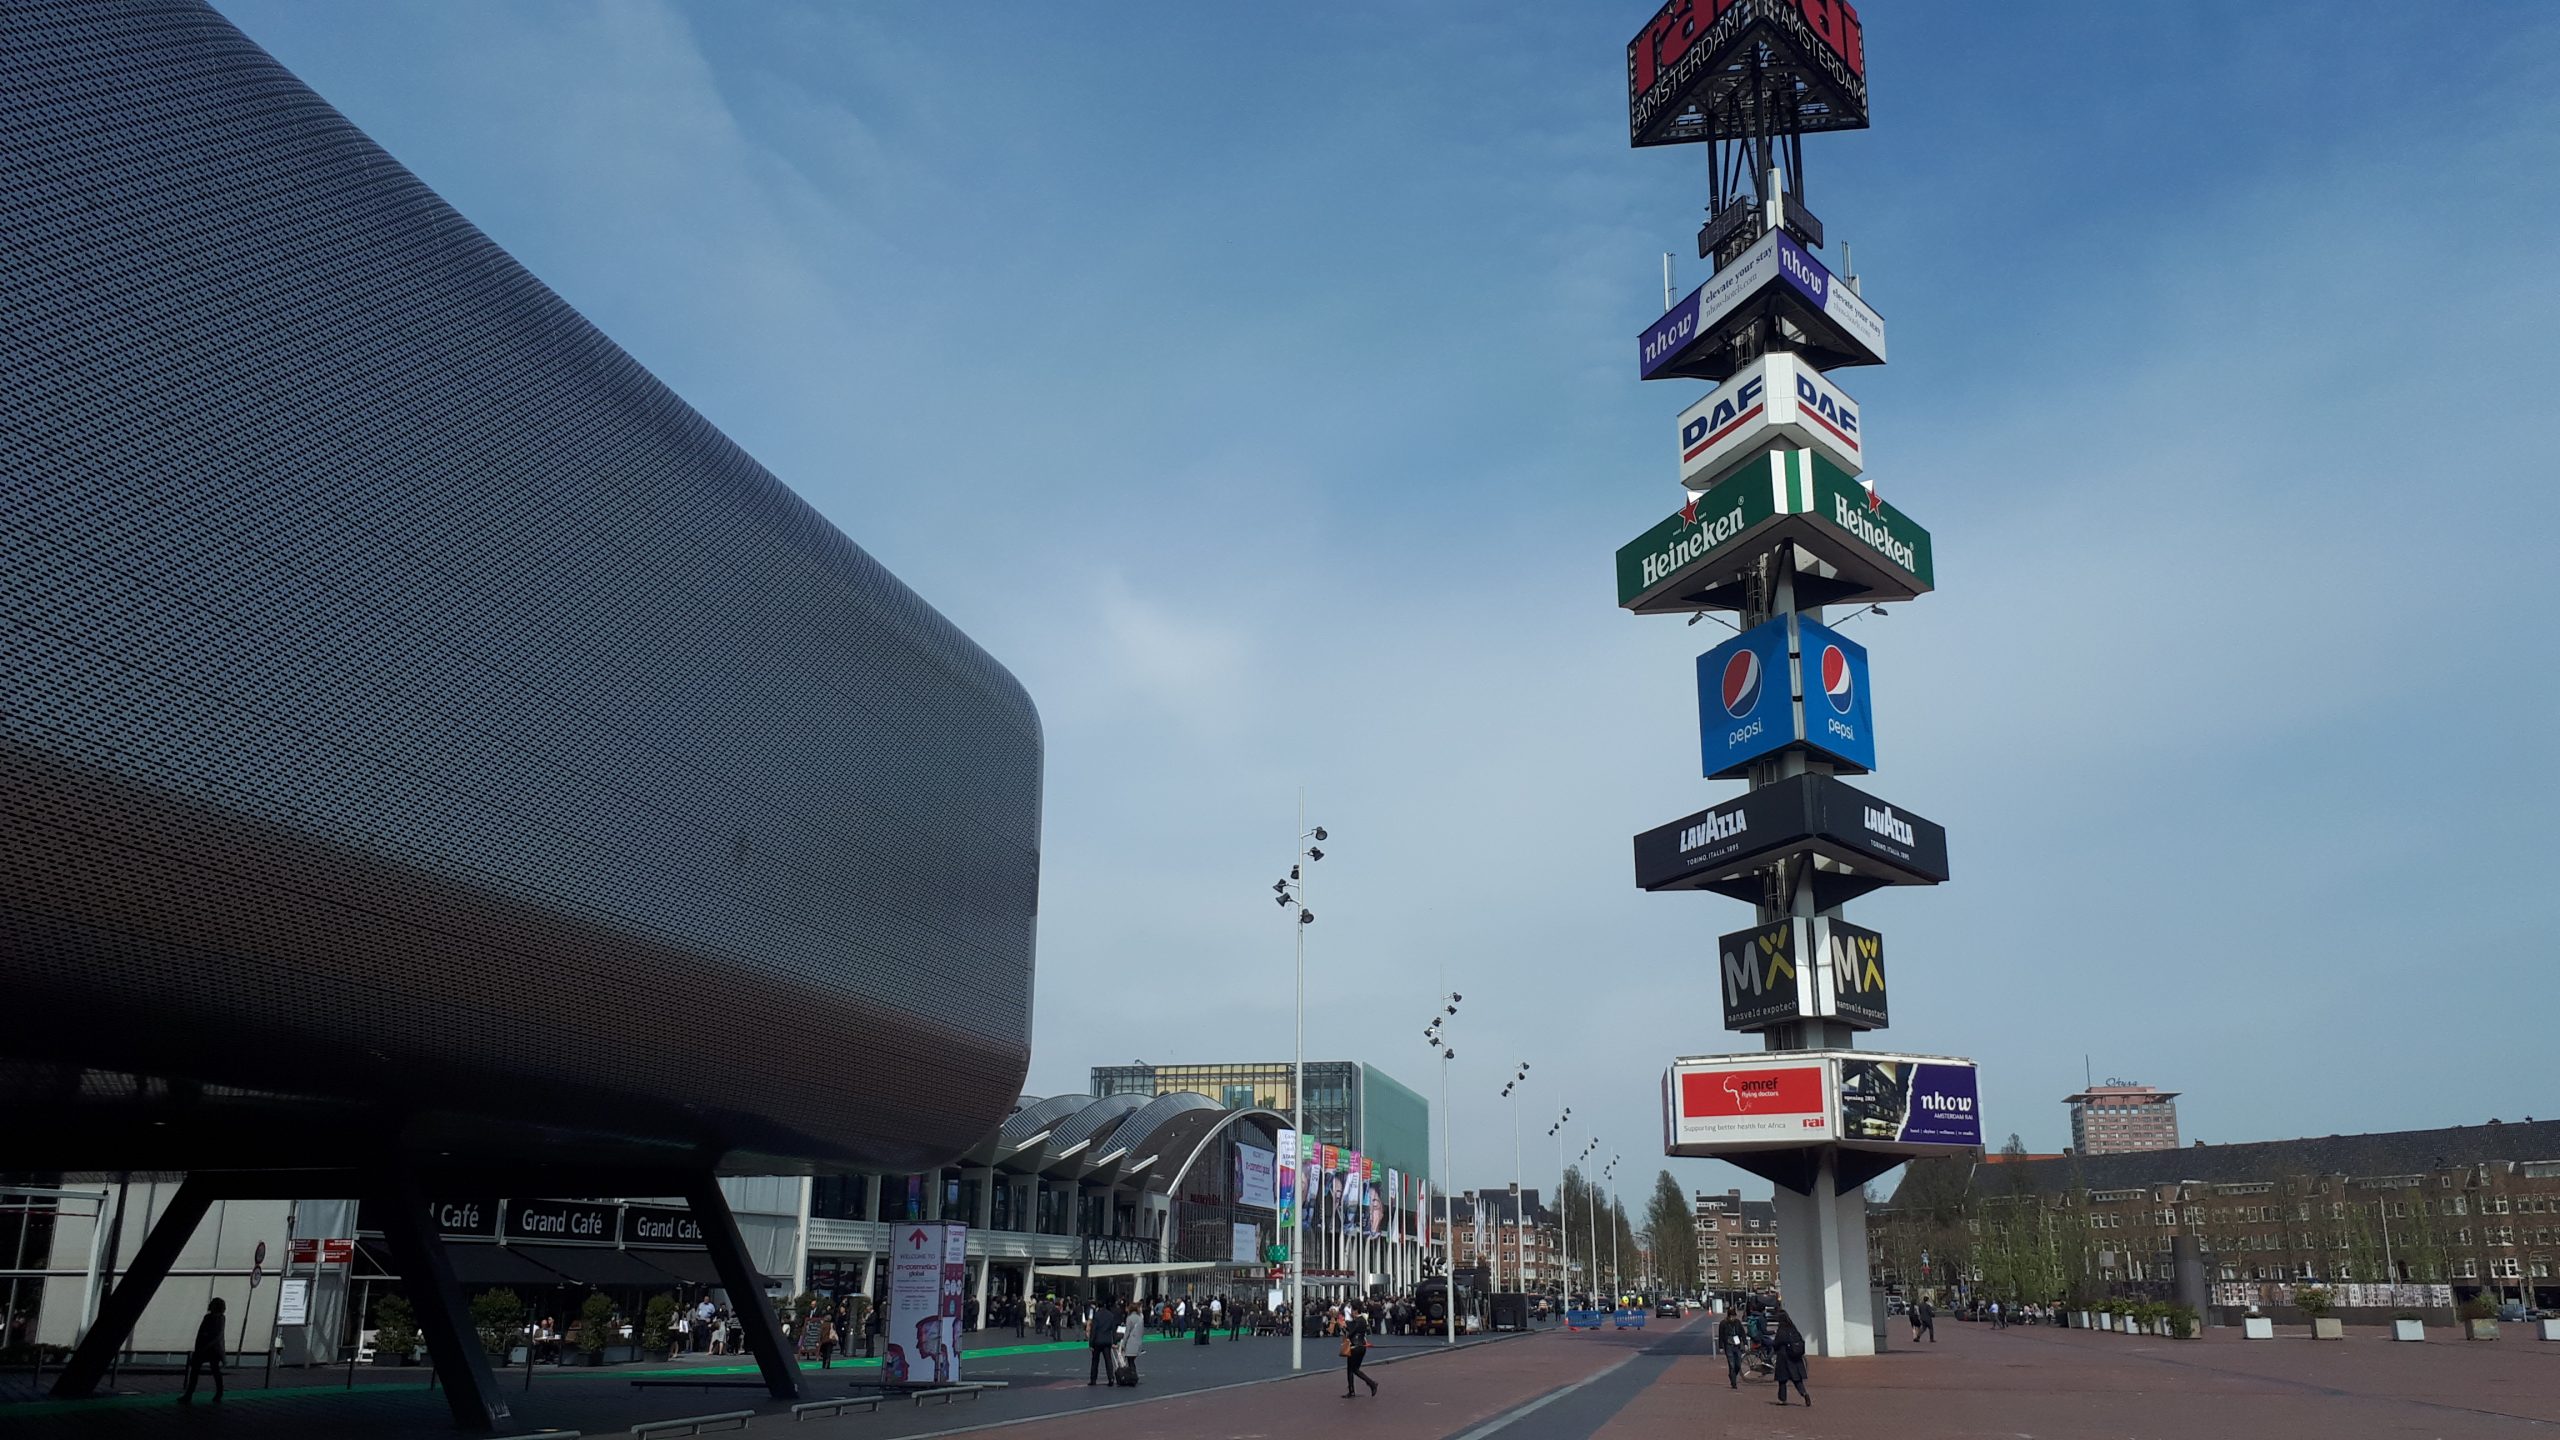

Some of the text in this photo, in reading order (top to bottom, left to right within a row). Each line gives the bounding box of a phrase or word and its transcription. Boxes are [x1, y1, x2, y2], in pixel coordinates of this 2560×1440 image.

[1636, 0, 1735, 95] ra
[1781, 6, 1866, 107] AMSTERDAM
[1784, 0, 1862, 79] ai
[1637, 8, 1739, 126] AMSTERDAM
[1705, 245, 1774, 304] elevate your stay
[1781, 247, 1822, 295] nhow
[1645, 313, 1692, 364] nhow
[1682, 374, 1762, 450] DAF
[1796, 373, 1857, 433] DAF
[1641, 505, 1745, 588] Heineken
[1834, 492, 1915, 573] Heineken
[1729, 717, 1762, 749] pepsi
[1828, 718, 1854, 741] pepsi
[1679, 809, 1747, 853] LAVAZZA
[1864, 805, 1915, 848] LAVAZZA
[1728, 1000, 1797, 1022] mansveld expotech
[1741, 1077, 1778, 1091] amref
[1921, 1091, 1972, 1112] nhow
[1684, 1124, 1717, 1133] Supporting
[1718, 1123, 1736, 1131] better
[1737, 1122, 1756, 1130] health
[1768, 1121, 1786, 1129] Africa
[1802, 1116, 1825, 1128] rai
[1934, 1112, 1964, 1120] AMSTERDAM
[441, 1203, 479, 1228] Café
[522, 1209, 602, 1235] Grand Café
[637, 1216, 675, 1238] Grand
